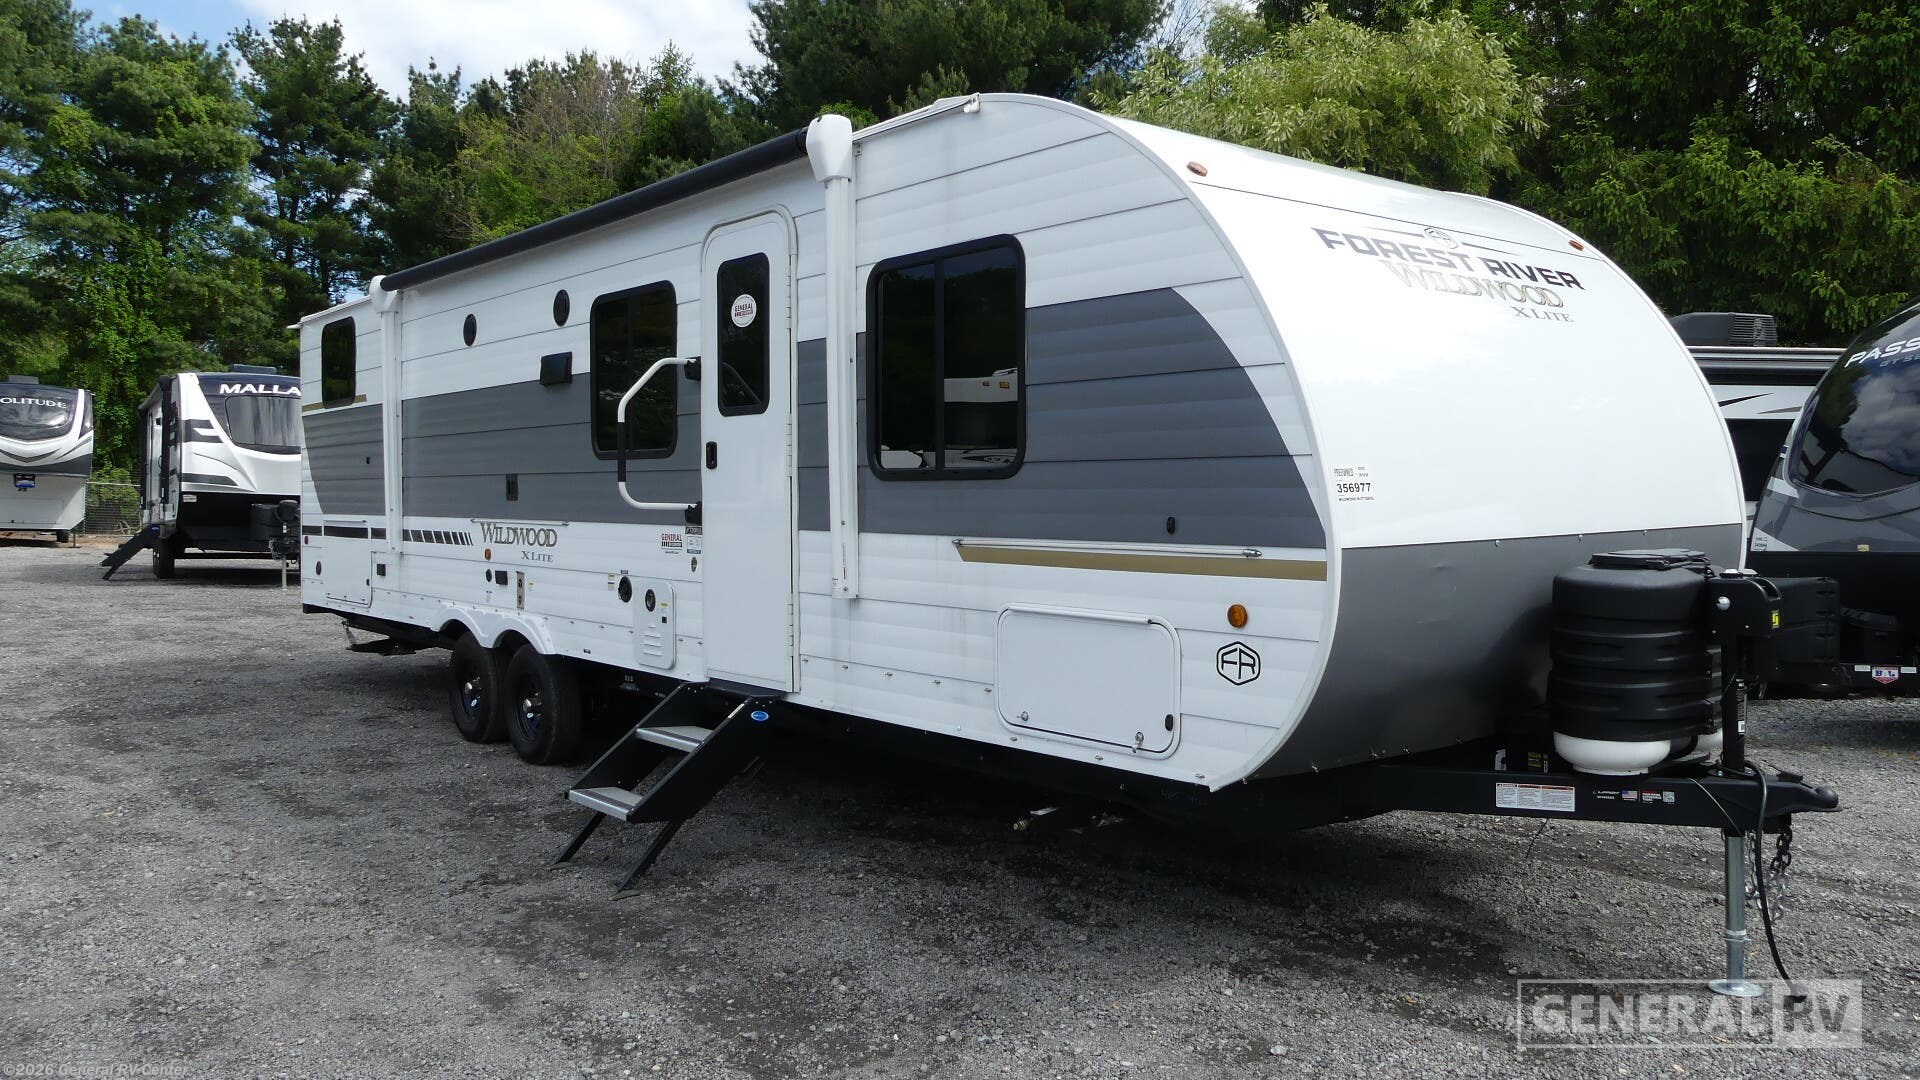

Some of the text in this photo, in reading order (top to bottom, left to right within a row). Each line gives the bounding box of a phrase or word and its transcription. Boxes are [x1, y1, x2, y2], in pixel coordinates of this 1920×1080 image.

[1311, 227, 1475, 272] FOREST
[1478, 256, 1586, 290] RIVER
[1378, 259, 1565, 308] WILDWOOD
[1336, 482, 1371, 493] 356977
[481, 522, 558, 547] WILDWOOD
[661, 533, 682, 542] GENERAL
